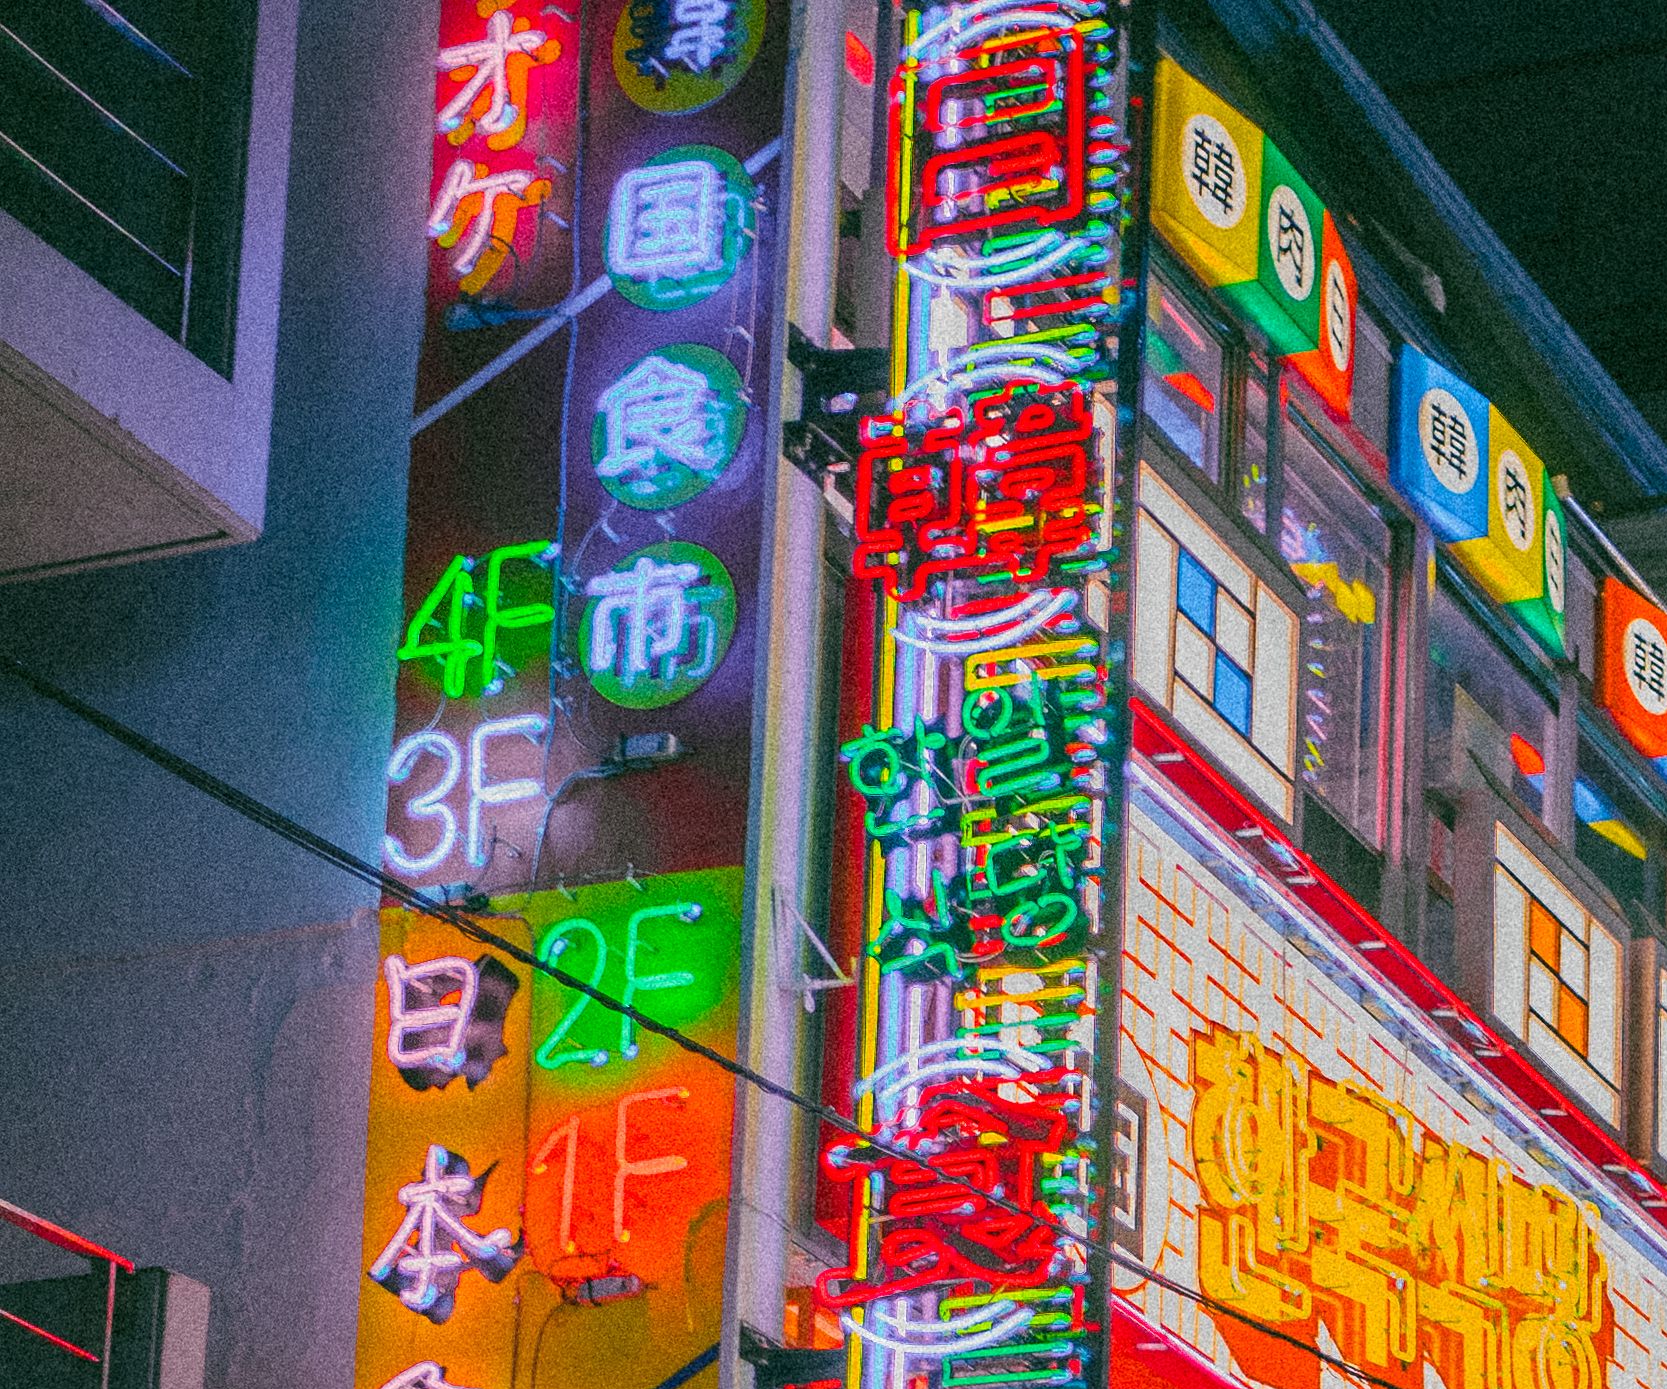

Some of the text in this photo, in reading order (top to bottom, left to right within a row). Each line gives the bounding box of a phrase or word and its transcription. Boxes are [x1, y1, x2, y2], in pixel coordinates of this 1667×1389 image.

[400, 538, 559, 697] 4F
[384, 716, 542, 872] 3F
[538, 902, 701, 1067] 2F
[532, 1087, 688, 1254] 1F
